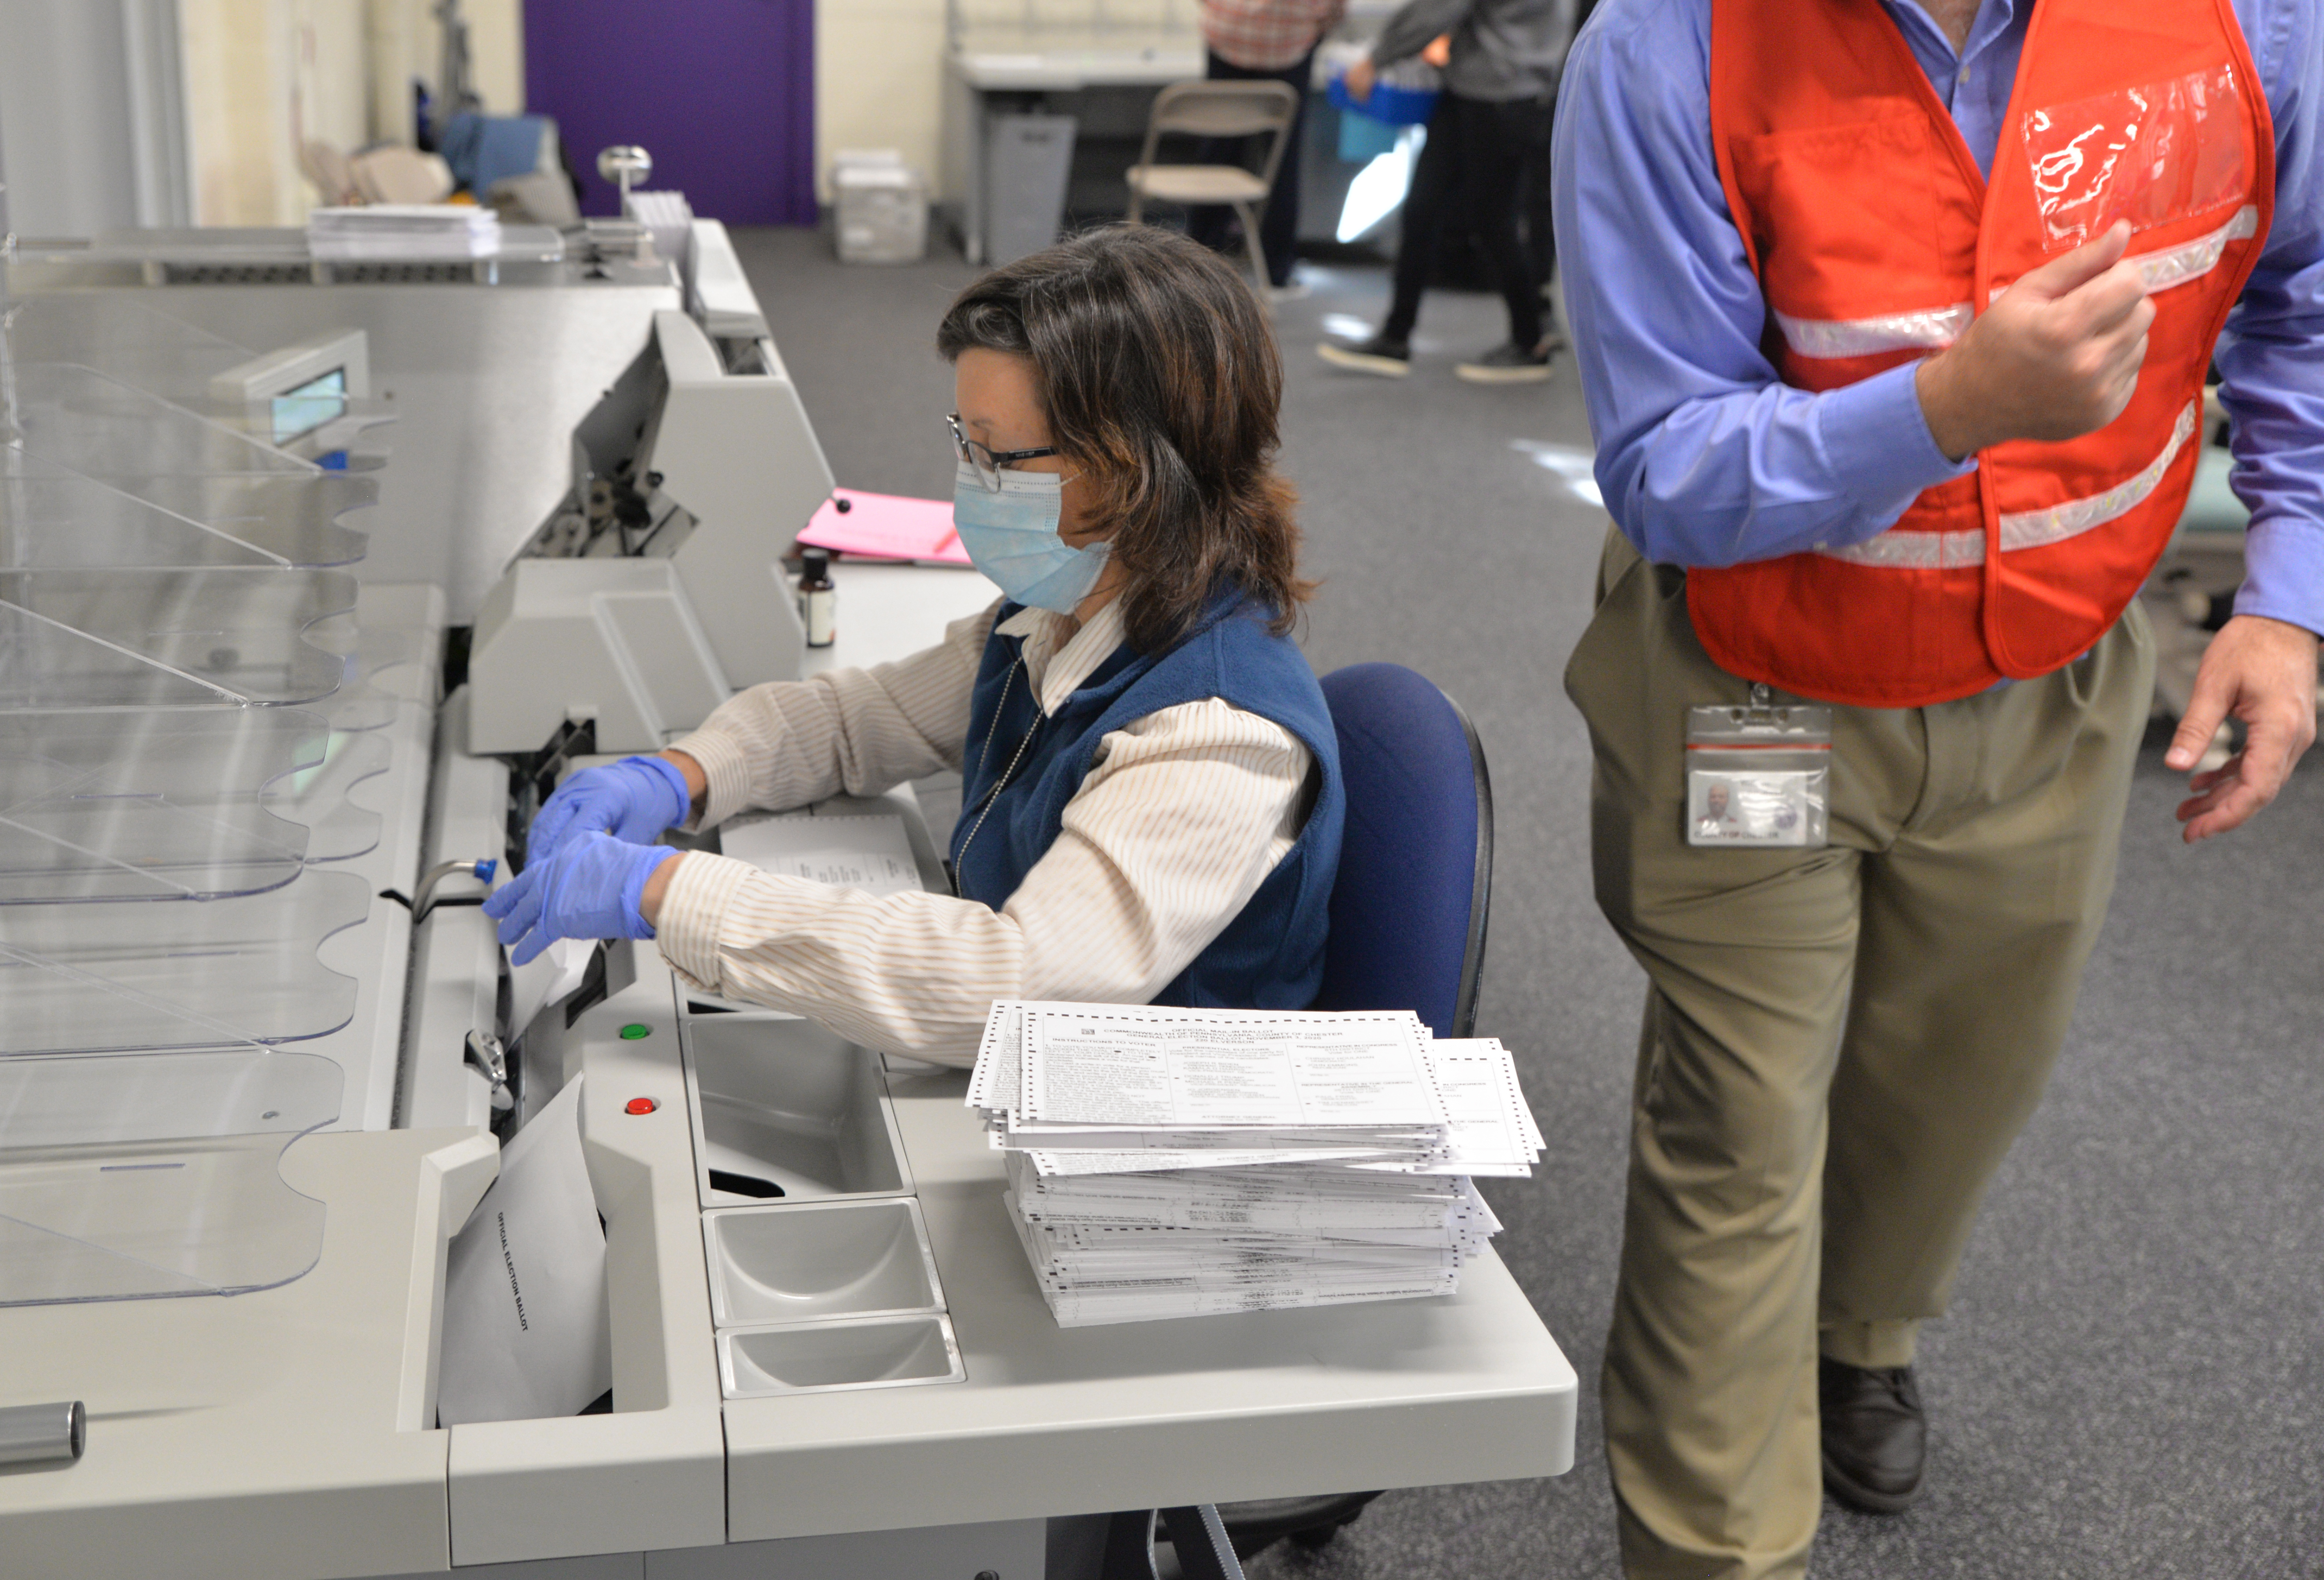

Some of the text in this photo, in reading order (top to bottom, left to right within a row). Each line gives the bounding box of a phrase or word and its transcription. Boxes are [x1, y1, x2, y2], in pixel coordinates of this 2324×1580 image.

[497, 1212, 528, 1332] OFFICIAL ELECTION BALLOT
